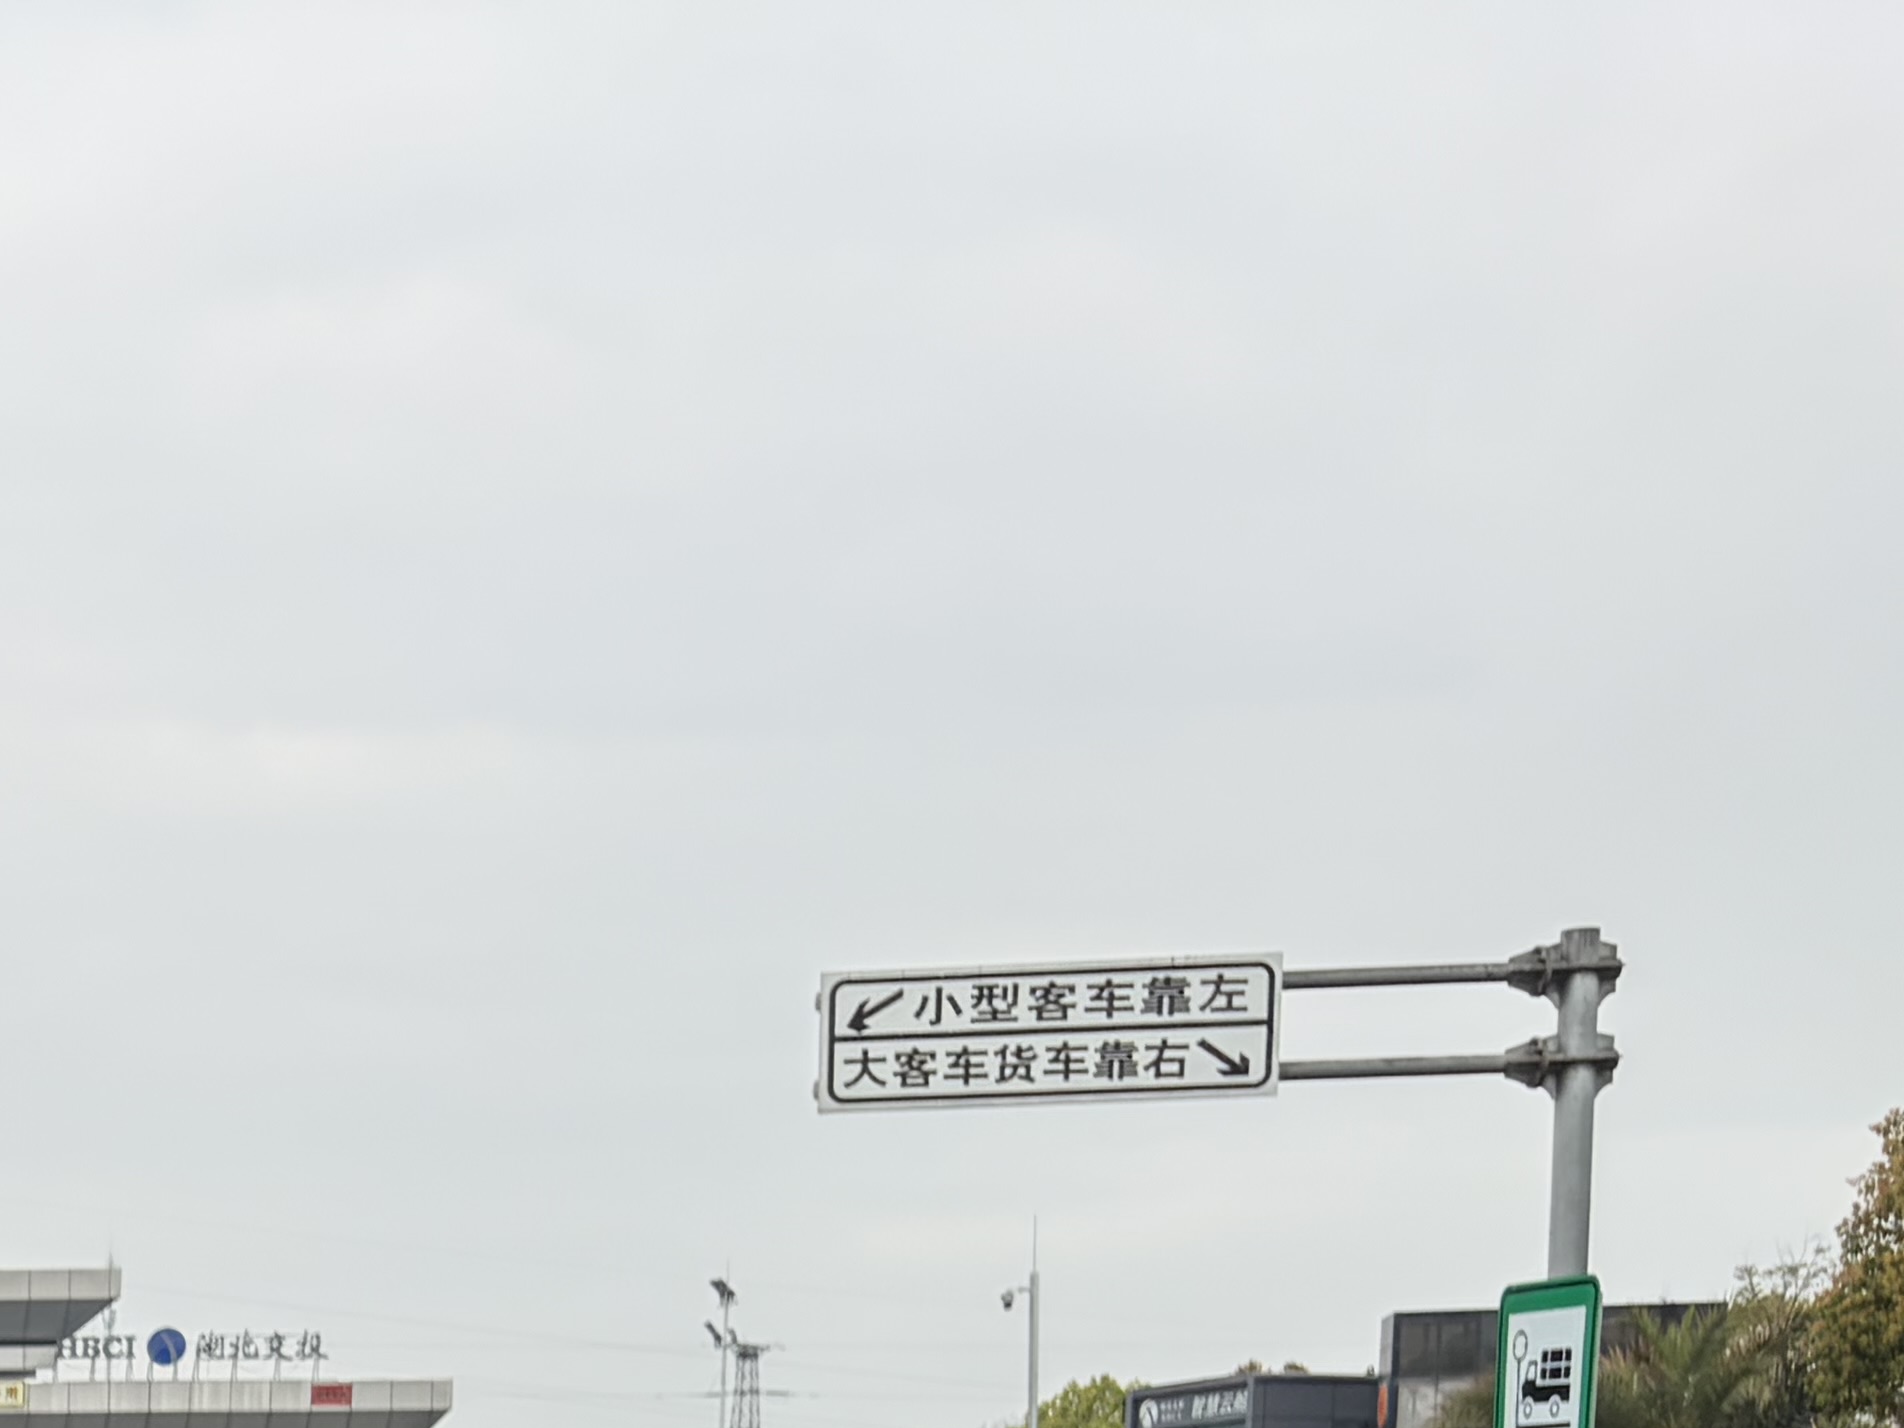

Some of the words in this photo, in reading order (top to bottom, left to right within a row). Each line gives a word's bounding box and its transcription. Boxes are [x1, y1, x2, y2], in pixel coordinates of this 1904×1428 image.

[913, 973, 1250, 1025] 小型客车靠左
[842, 1036, 1191, 1089] 大客车货车靠右
[196, 1330, 330, 1362] 湖北交投
